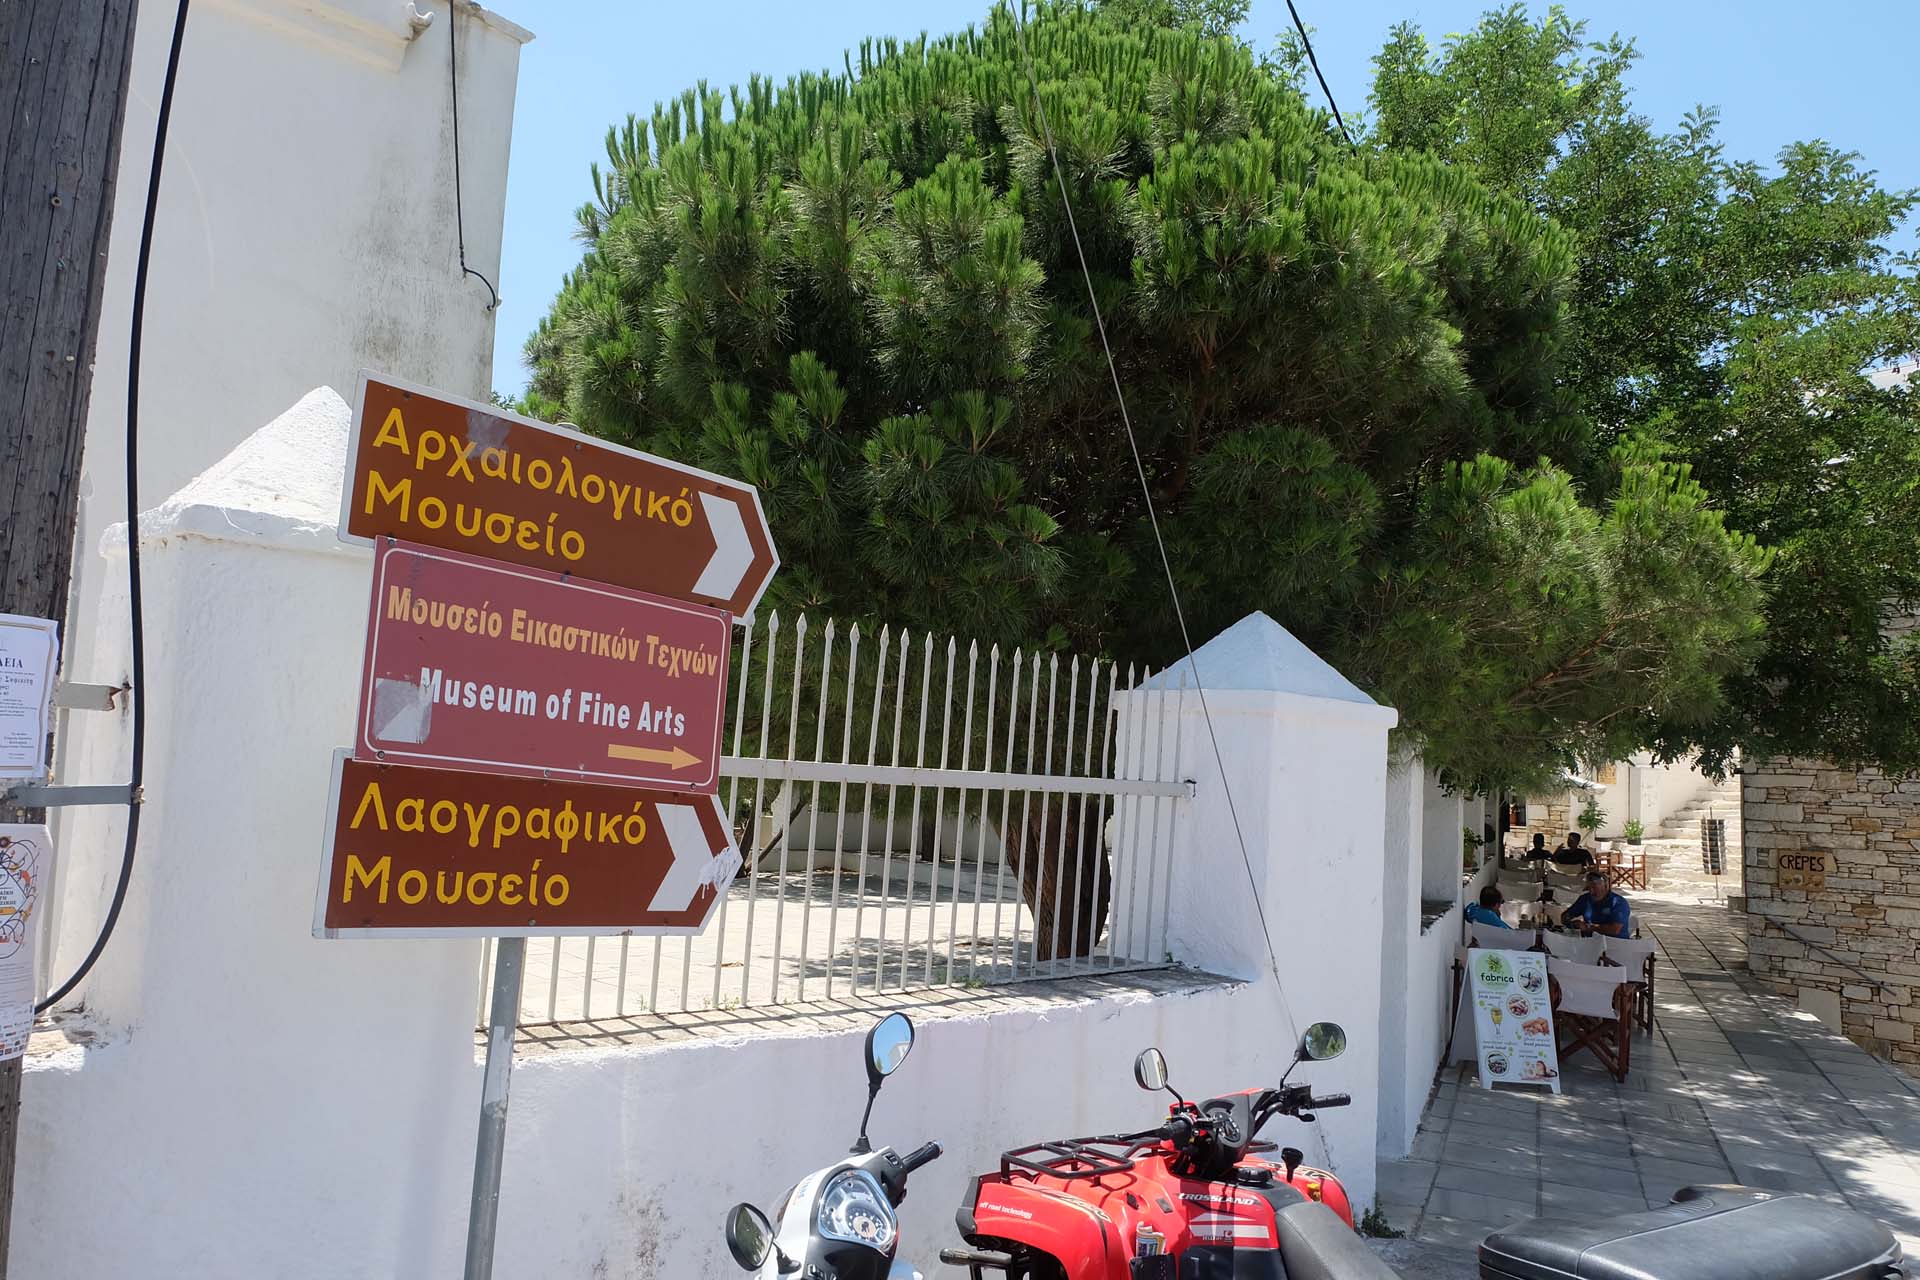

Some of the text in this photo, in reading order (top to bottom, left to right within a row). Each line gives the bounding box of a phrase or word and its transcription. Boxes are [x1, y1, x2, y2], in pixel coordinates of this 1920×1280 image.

[372, 406, 694, 528] Αρχαιολογικό
[364, 469, 586, 561] Μουσείο
[386, 585, 718, 678] Μουσείο Εικαστικών Τεχνών
[419, 667, 686, 737] Museum of Fine Arts
[349, 781, 647, 853] Λαογραφικό
[342, 854, 570, 906] Μουσείο
[1481, 972, 1515, 983] fabrica
[988, 1203, 1002, 1211] road
[1001, 1206, 1033, 1220] technology
[1178, 1193, 1255, 1206] CROSSLAND
